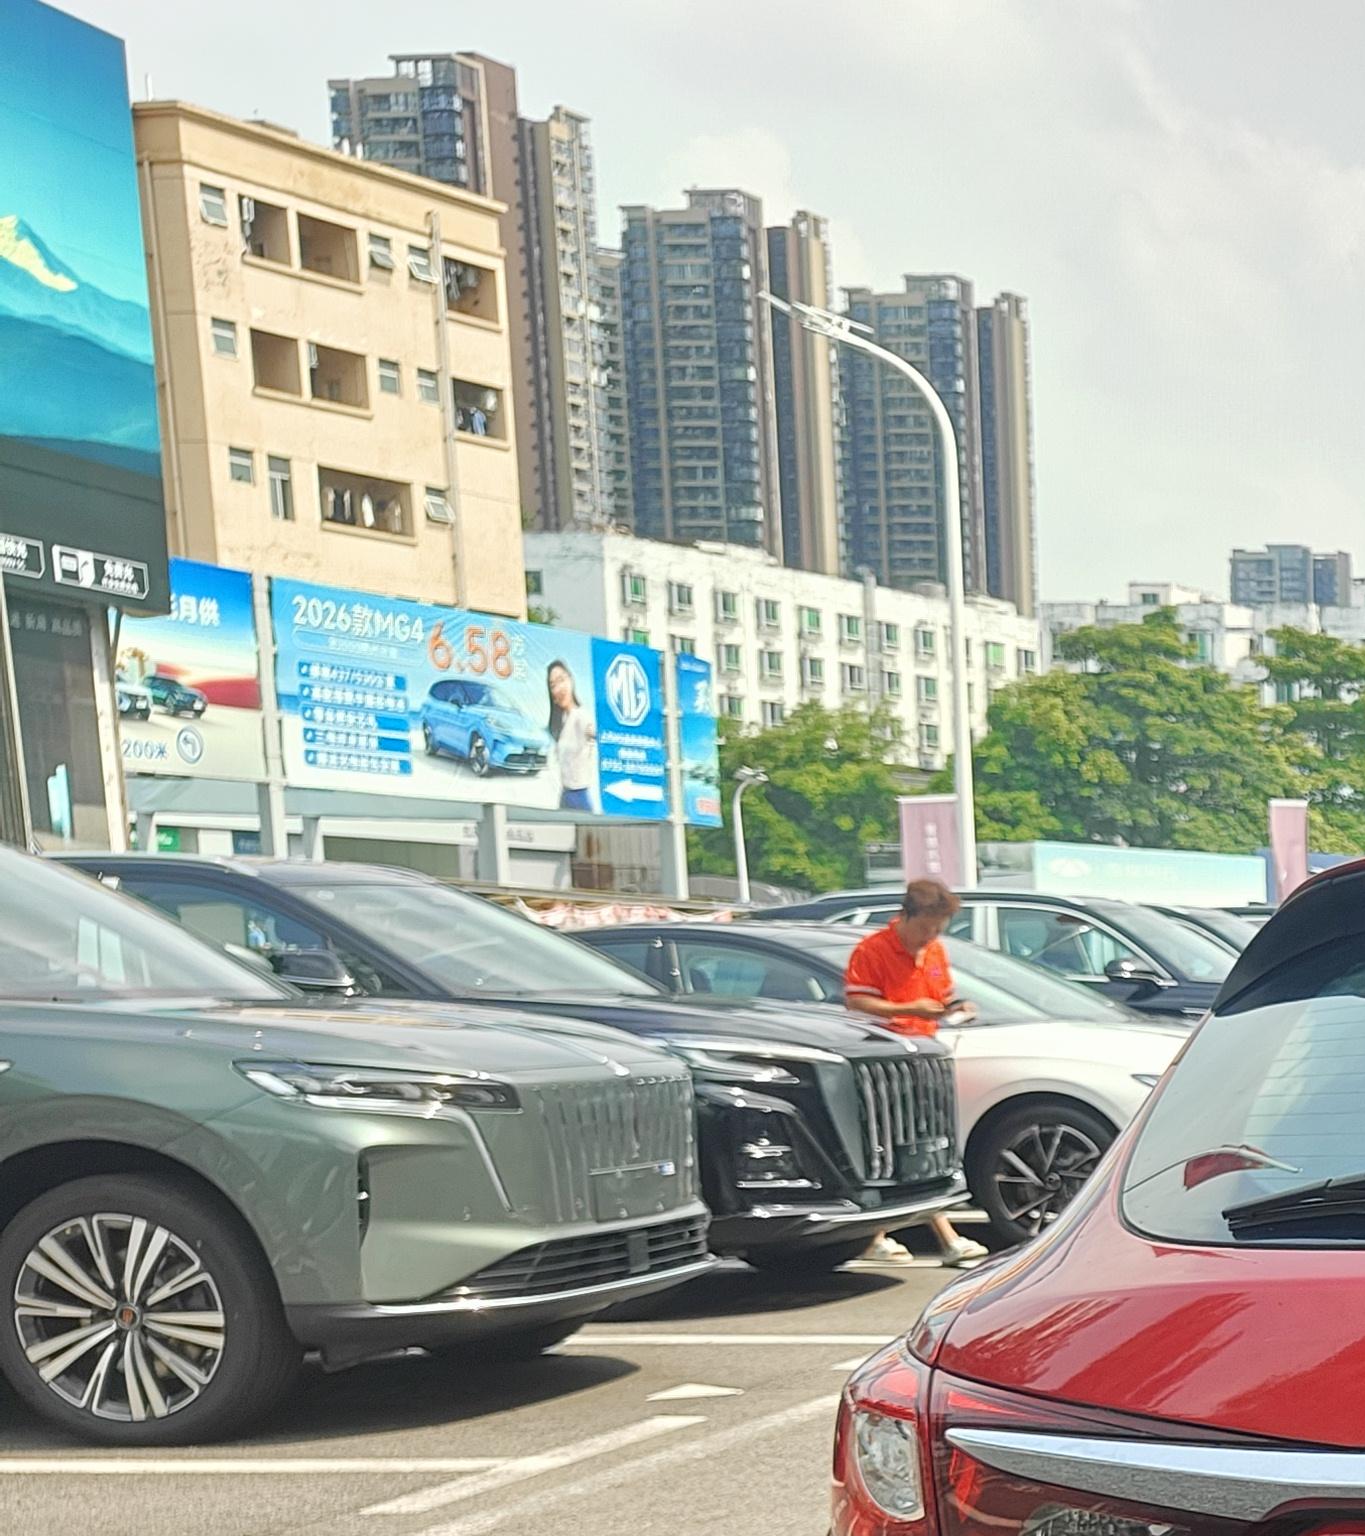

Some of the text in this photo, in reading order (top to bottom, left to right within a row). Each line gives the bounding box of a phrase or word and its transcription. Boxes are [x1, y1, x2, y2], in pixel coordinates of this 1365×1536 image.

[292, 595, 426, 644] 2026款MG4
[428, 621, 512, 679] 6.58
[607, 657, 649, 724] MG
